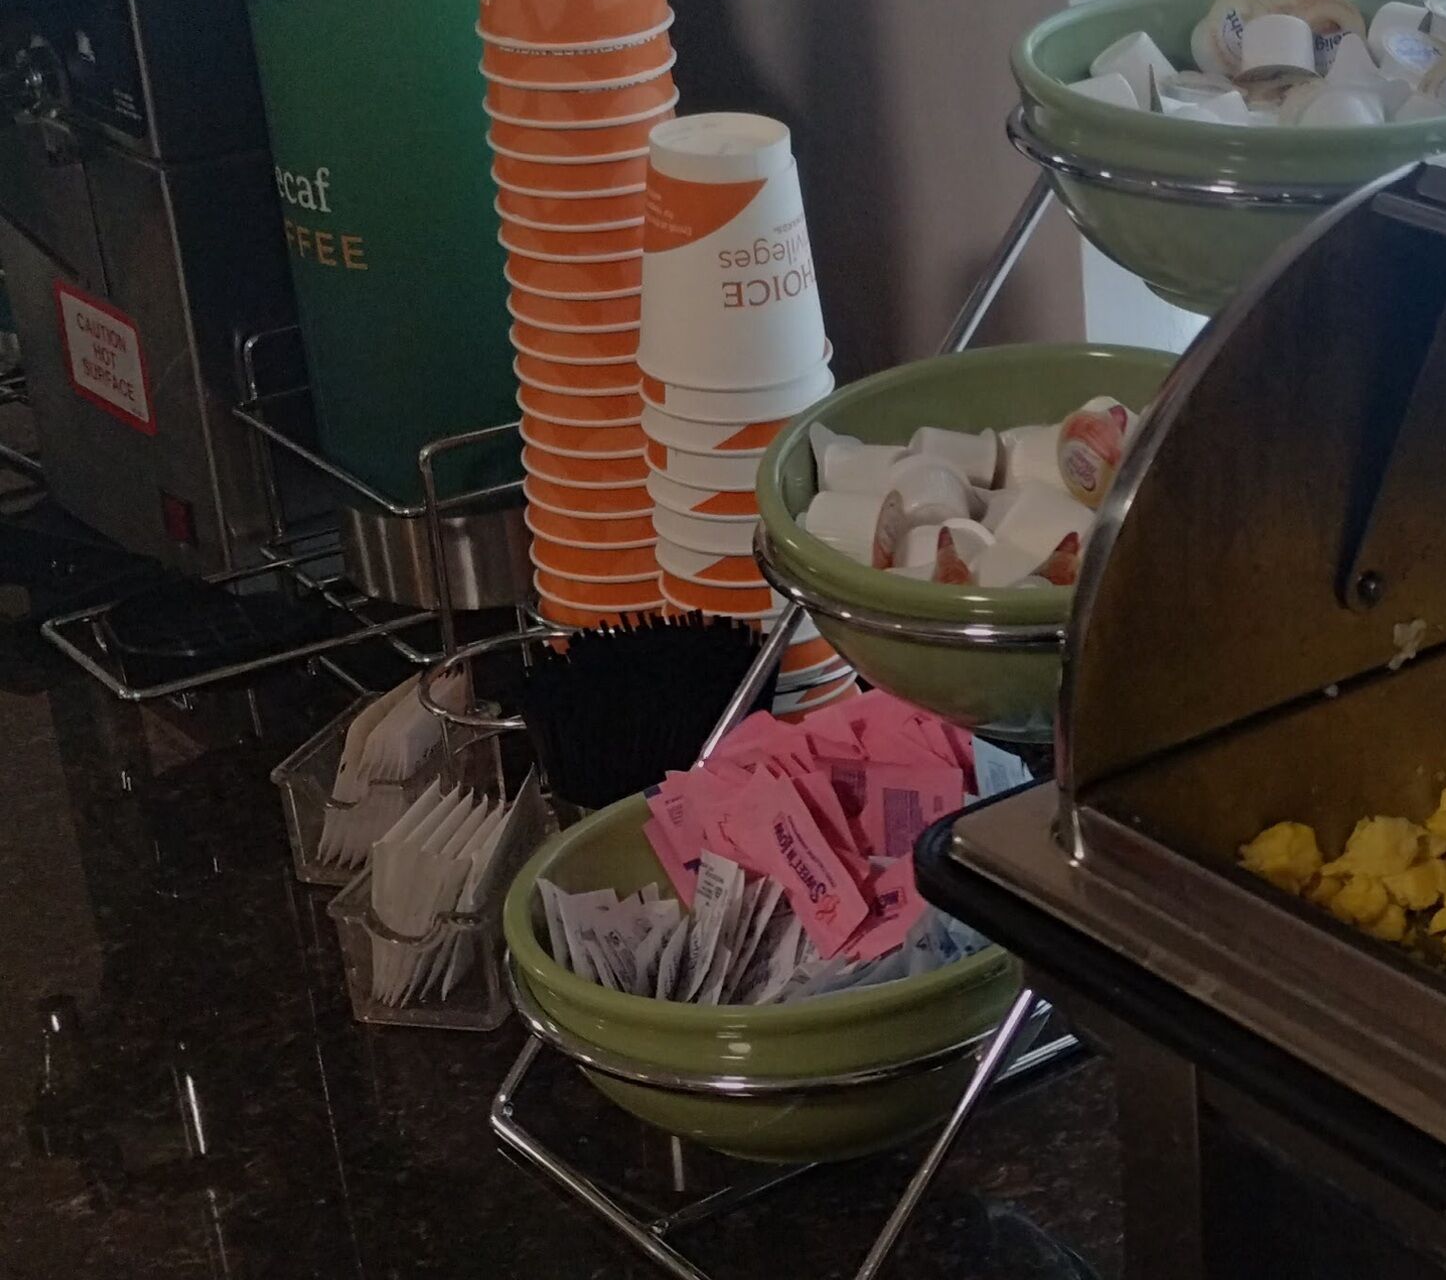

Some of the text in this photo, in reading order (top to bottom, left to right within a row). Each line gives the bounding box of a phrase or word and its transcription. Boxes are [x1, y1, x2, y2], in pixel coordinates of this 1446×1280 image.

[275, 166, 332, 213] ecaf
[283, 218, 369, 271] FFEE
[76, 312, 127, 353] CAUTION
[93, 343, 117, 369] HOT
[82, 358, 135, 401] SURFACE
